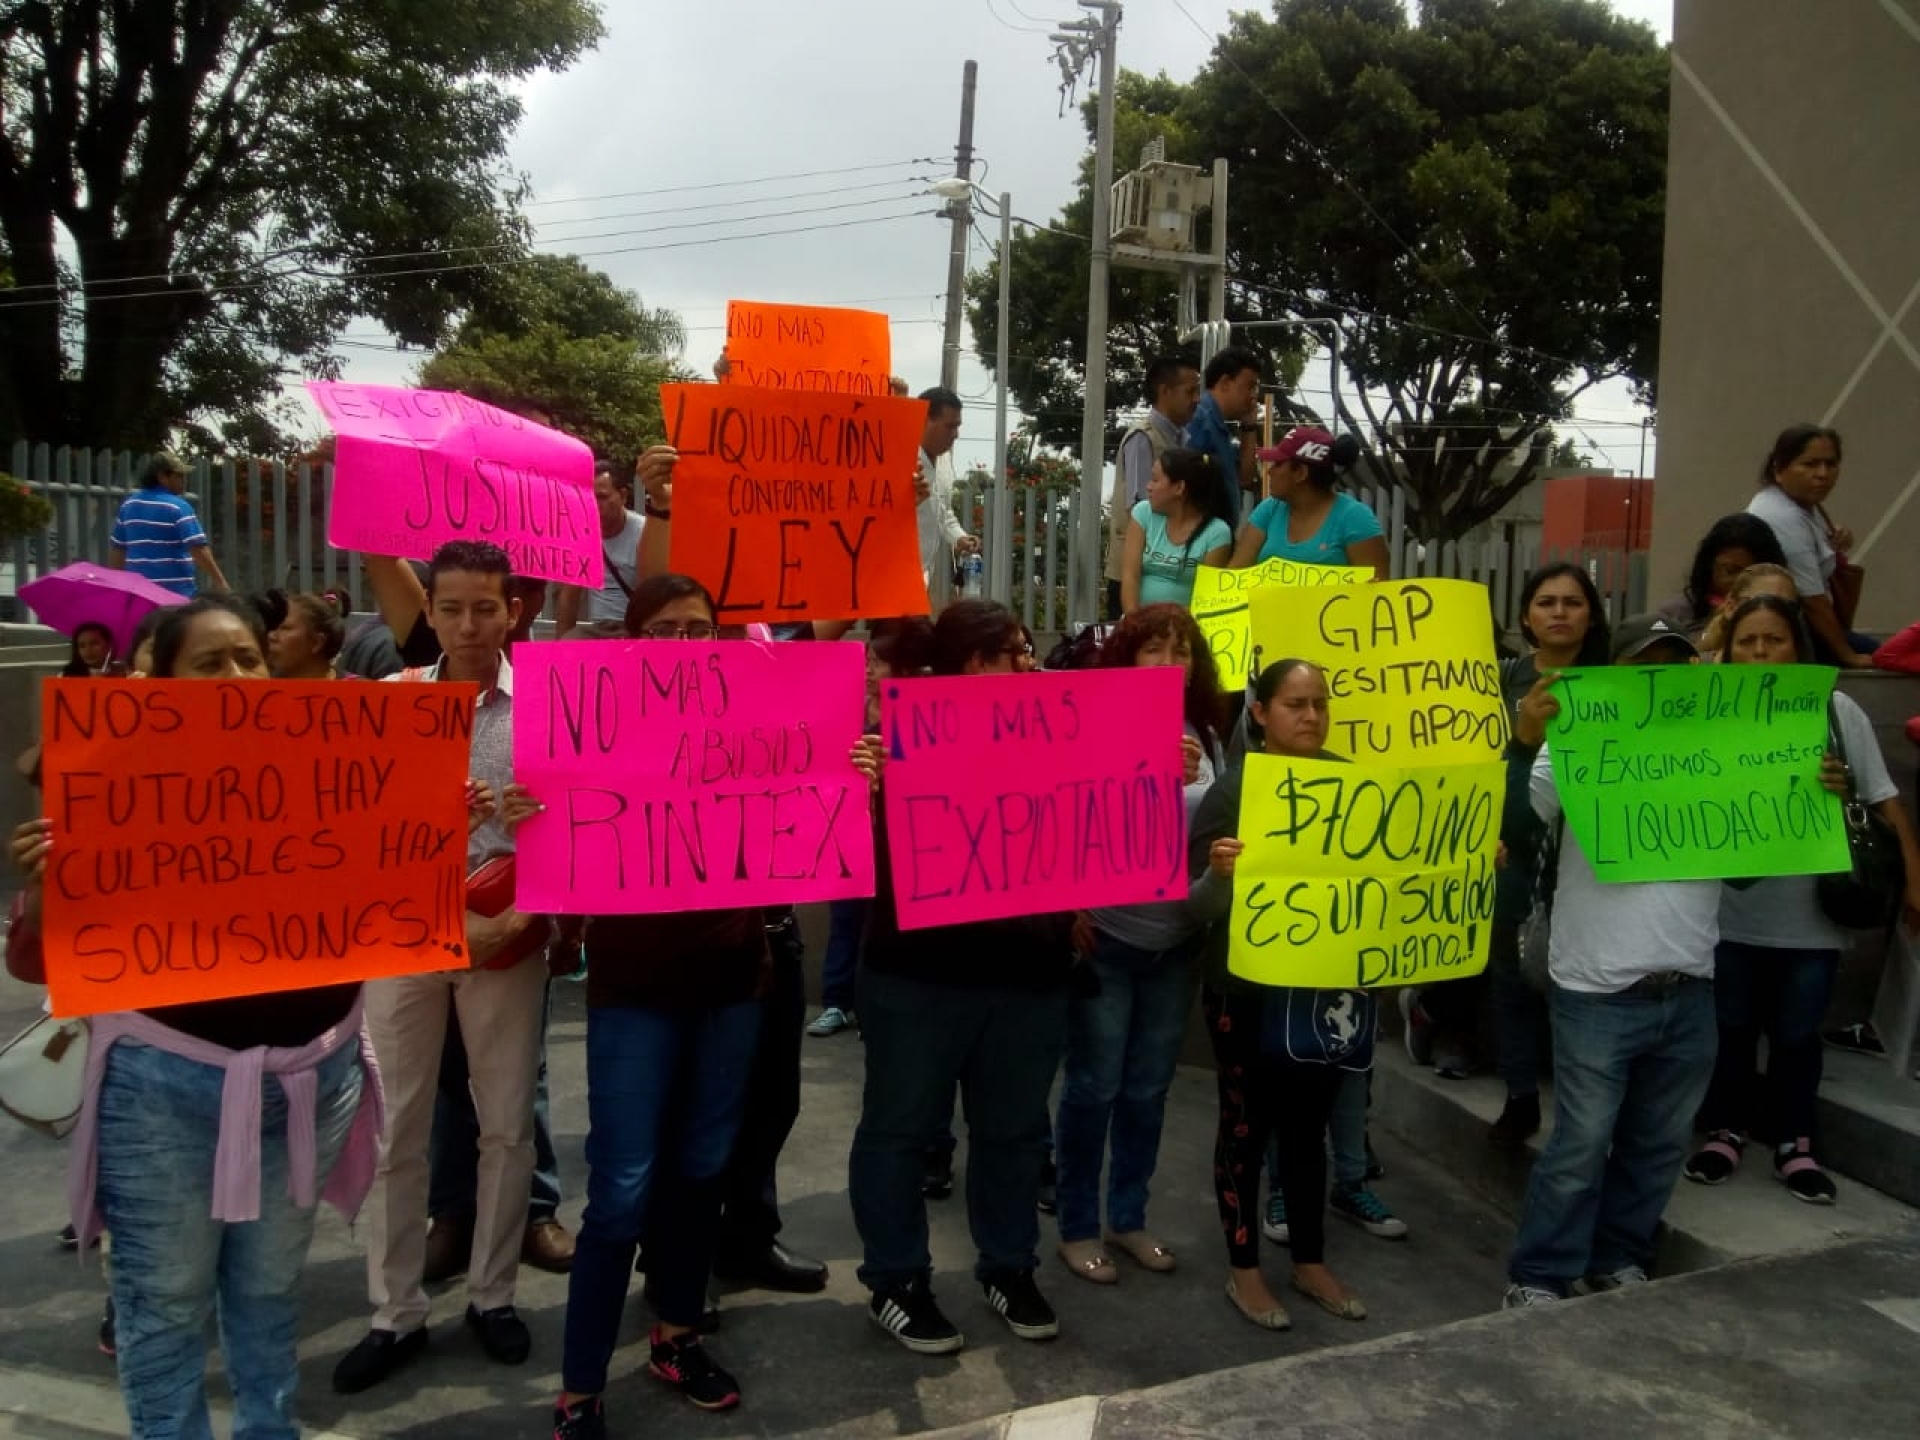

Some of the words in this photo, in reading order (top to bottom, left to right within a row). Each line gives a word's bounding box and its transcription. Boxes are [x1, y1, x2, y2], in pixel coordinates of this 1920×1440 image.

[777, 312, 825, 348] MAS
[671, 391, 885, 471] LIQUIDACIÓN
[727, 473, 836, 517] CONFORME
[847, 477, 860, 506] A
[869, 478, 894, 510] LA
[716, 516, 877, 612] LEY
[1319, 583, 1434, 652] GAP
[52, 688, 184, 743] NOS
[216, 683, 389, 743] DEJAN
[412, 694, 475, 742] SIN
[548, 662, 620, 760] NO
[641, 652, 730, 718] MAS
[887, 686, 961, 761] ¡NO
[991, 689, 1081, 744] MAS
[1705, 671, 1746, 721] Del
[669, 720, 814, 789] ABUSOS
[1334, 719, 1392, 754] TU
[1556, 749, 1589, 786] Te
[1596, 739, 1722, 785] EXIGIMOS
[312, 754, 397, 822] HAY
[1595, 774, 1833, 865] LIQUIDACIÓN
[56, 828, 347, 900] CULPABLES
[566, 785, 854, 891] RINTEX
[1245, 881, 1322, 948] ES
